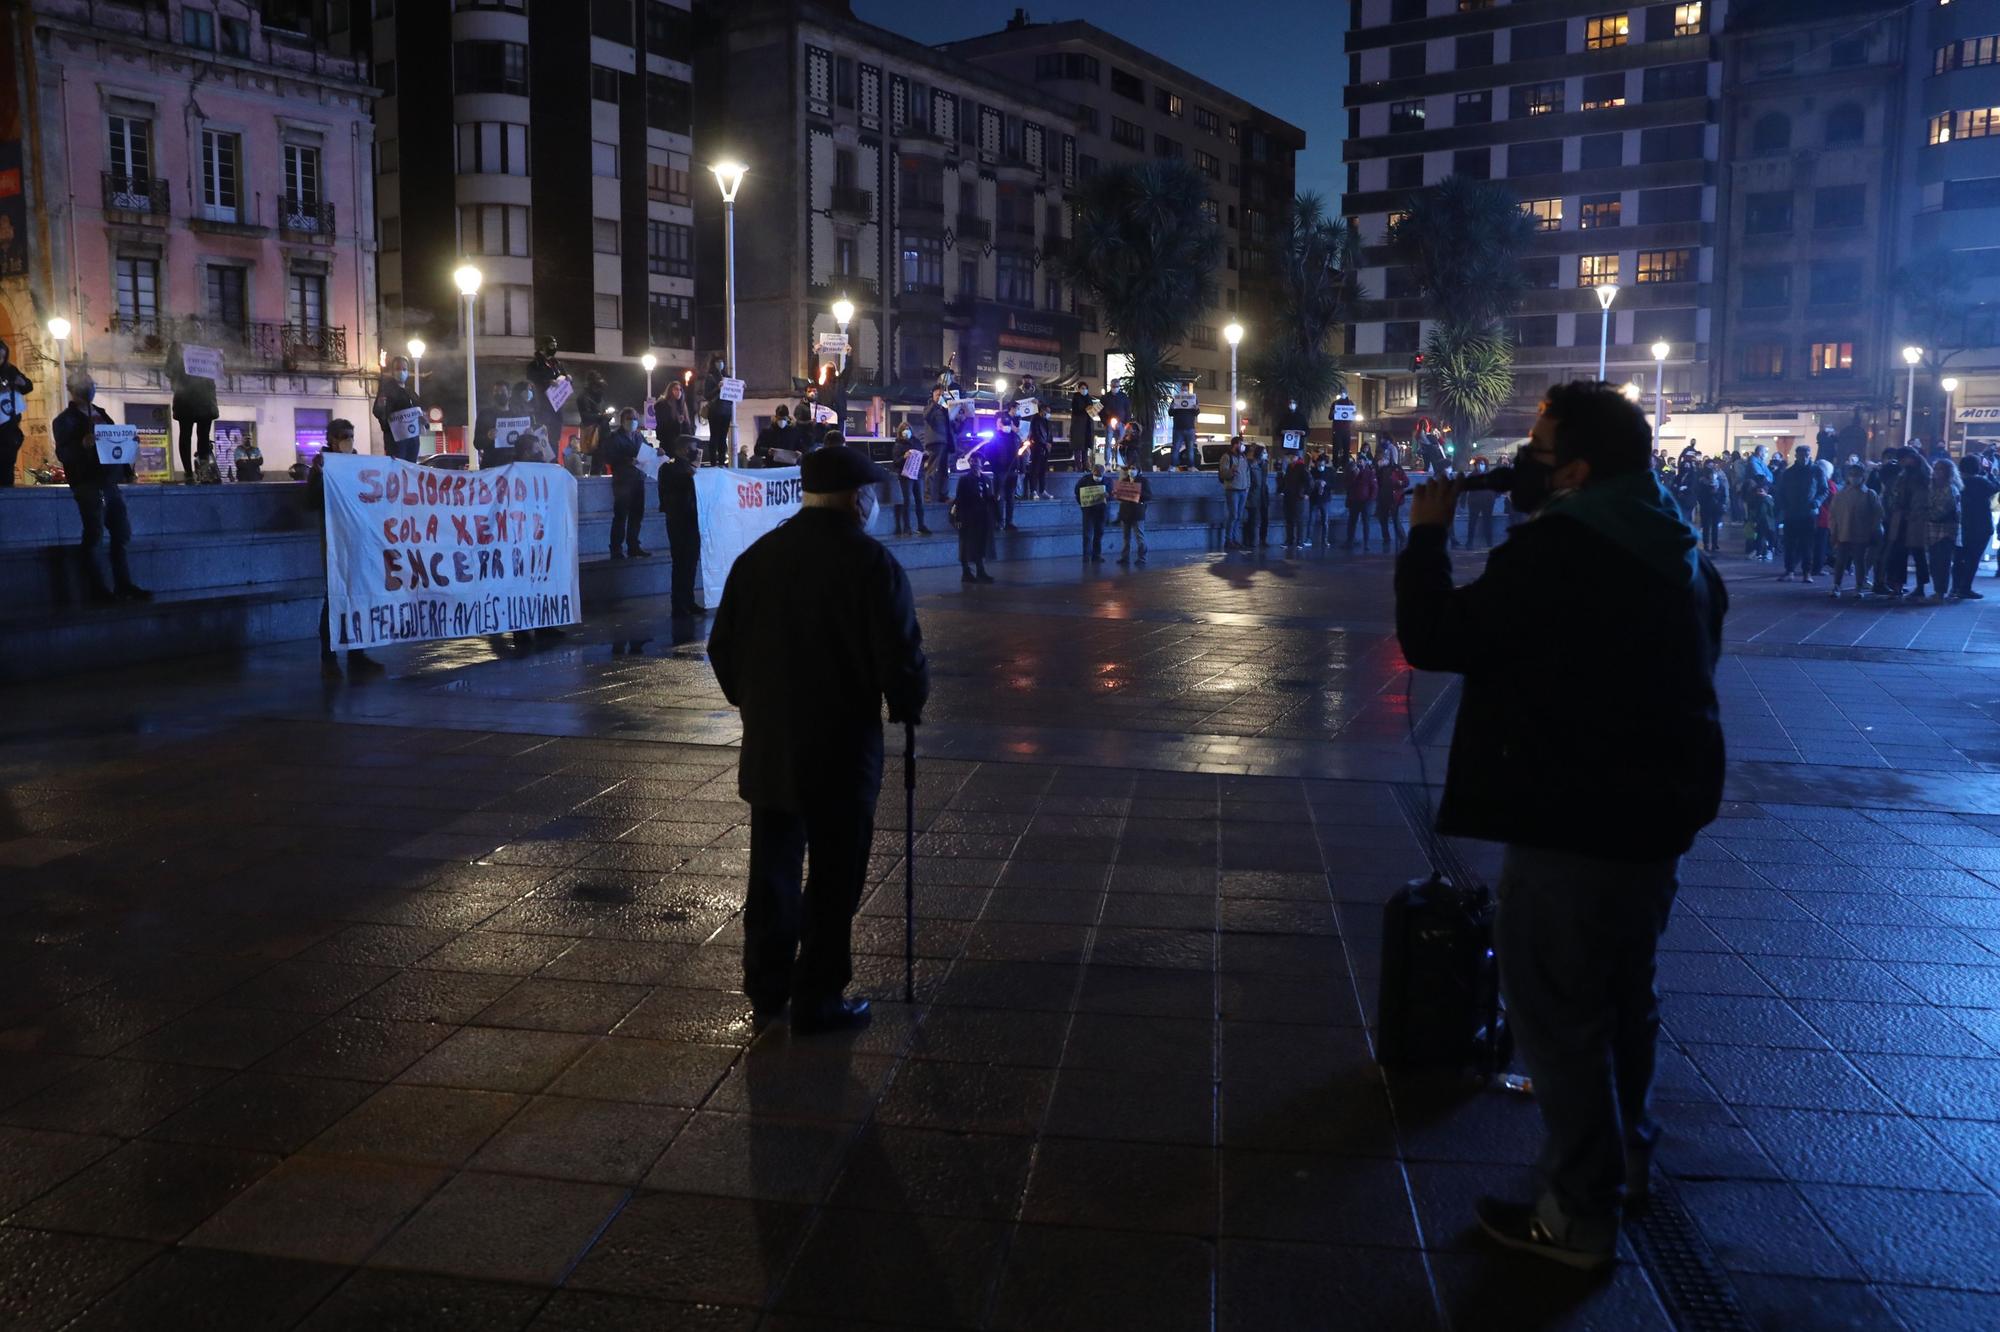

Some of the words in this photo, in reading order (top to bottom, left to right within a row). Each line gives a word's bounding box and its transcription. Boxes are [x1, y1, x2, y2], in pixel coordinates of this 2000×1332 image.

[737, 482, 763, 509] SOS
[384, 514, 438, 544] COLA
[451, 510, 545, 546] XENTE
[339, 611, 364, 644] LA
